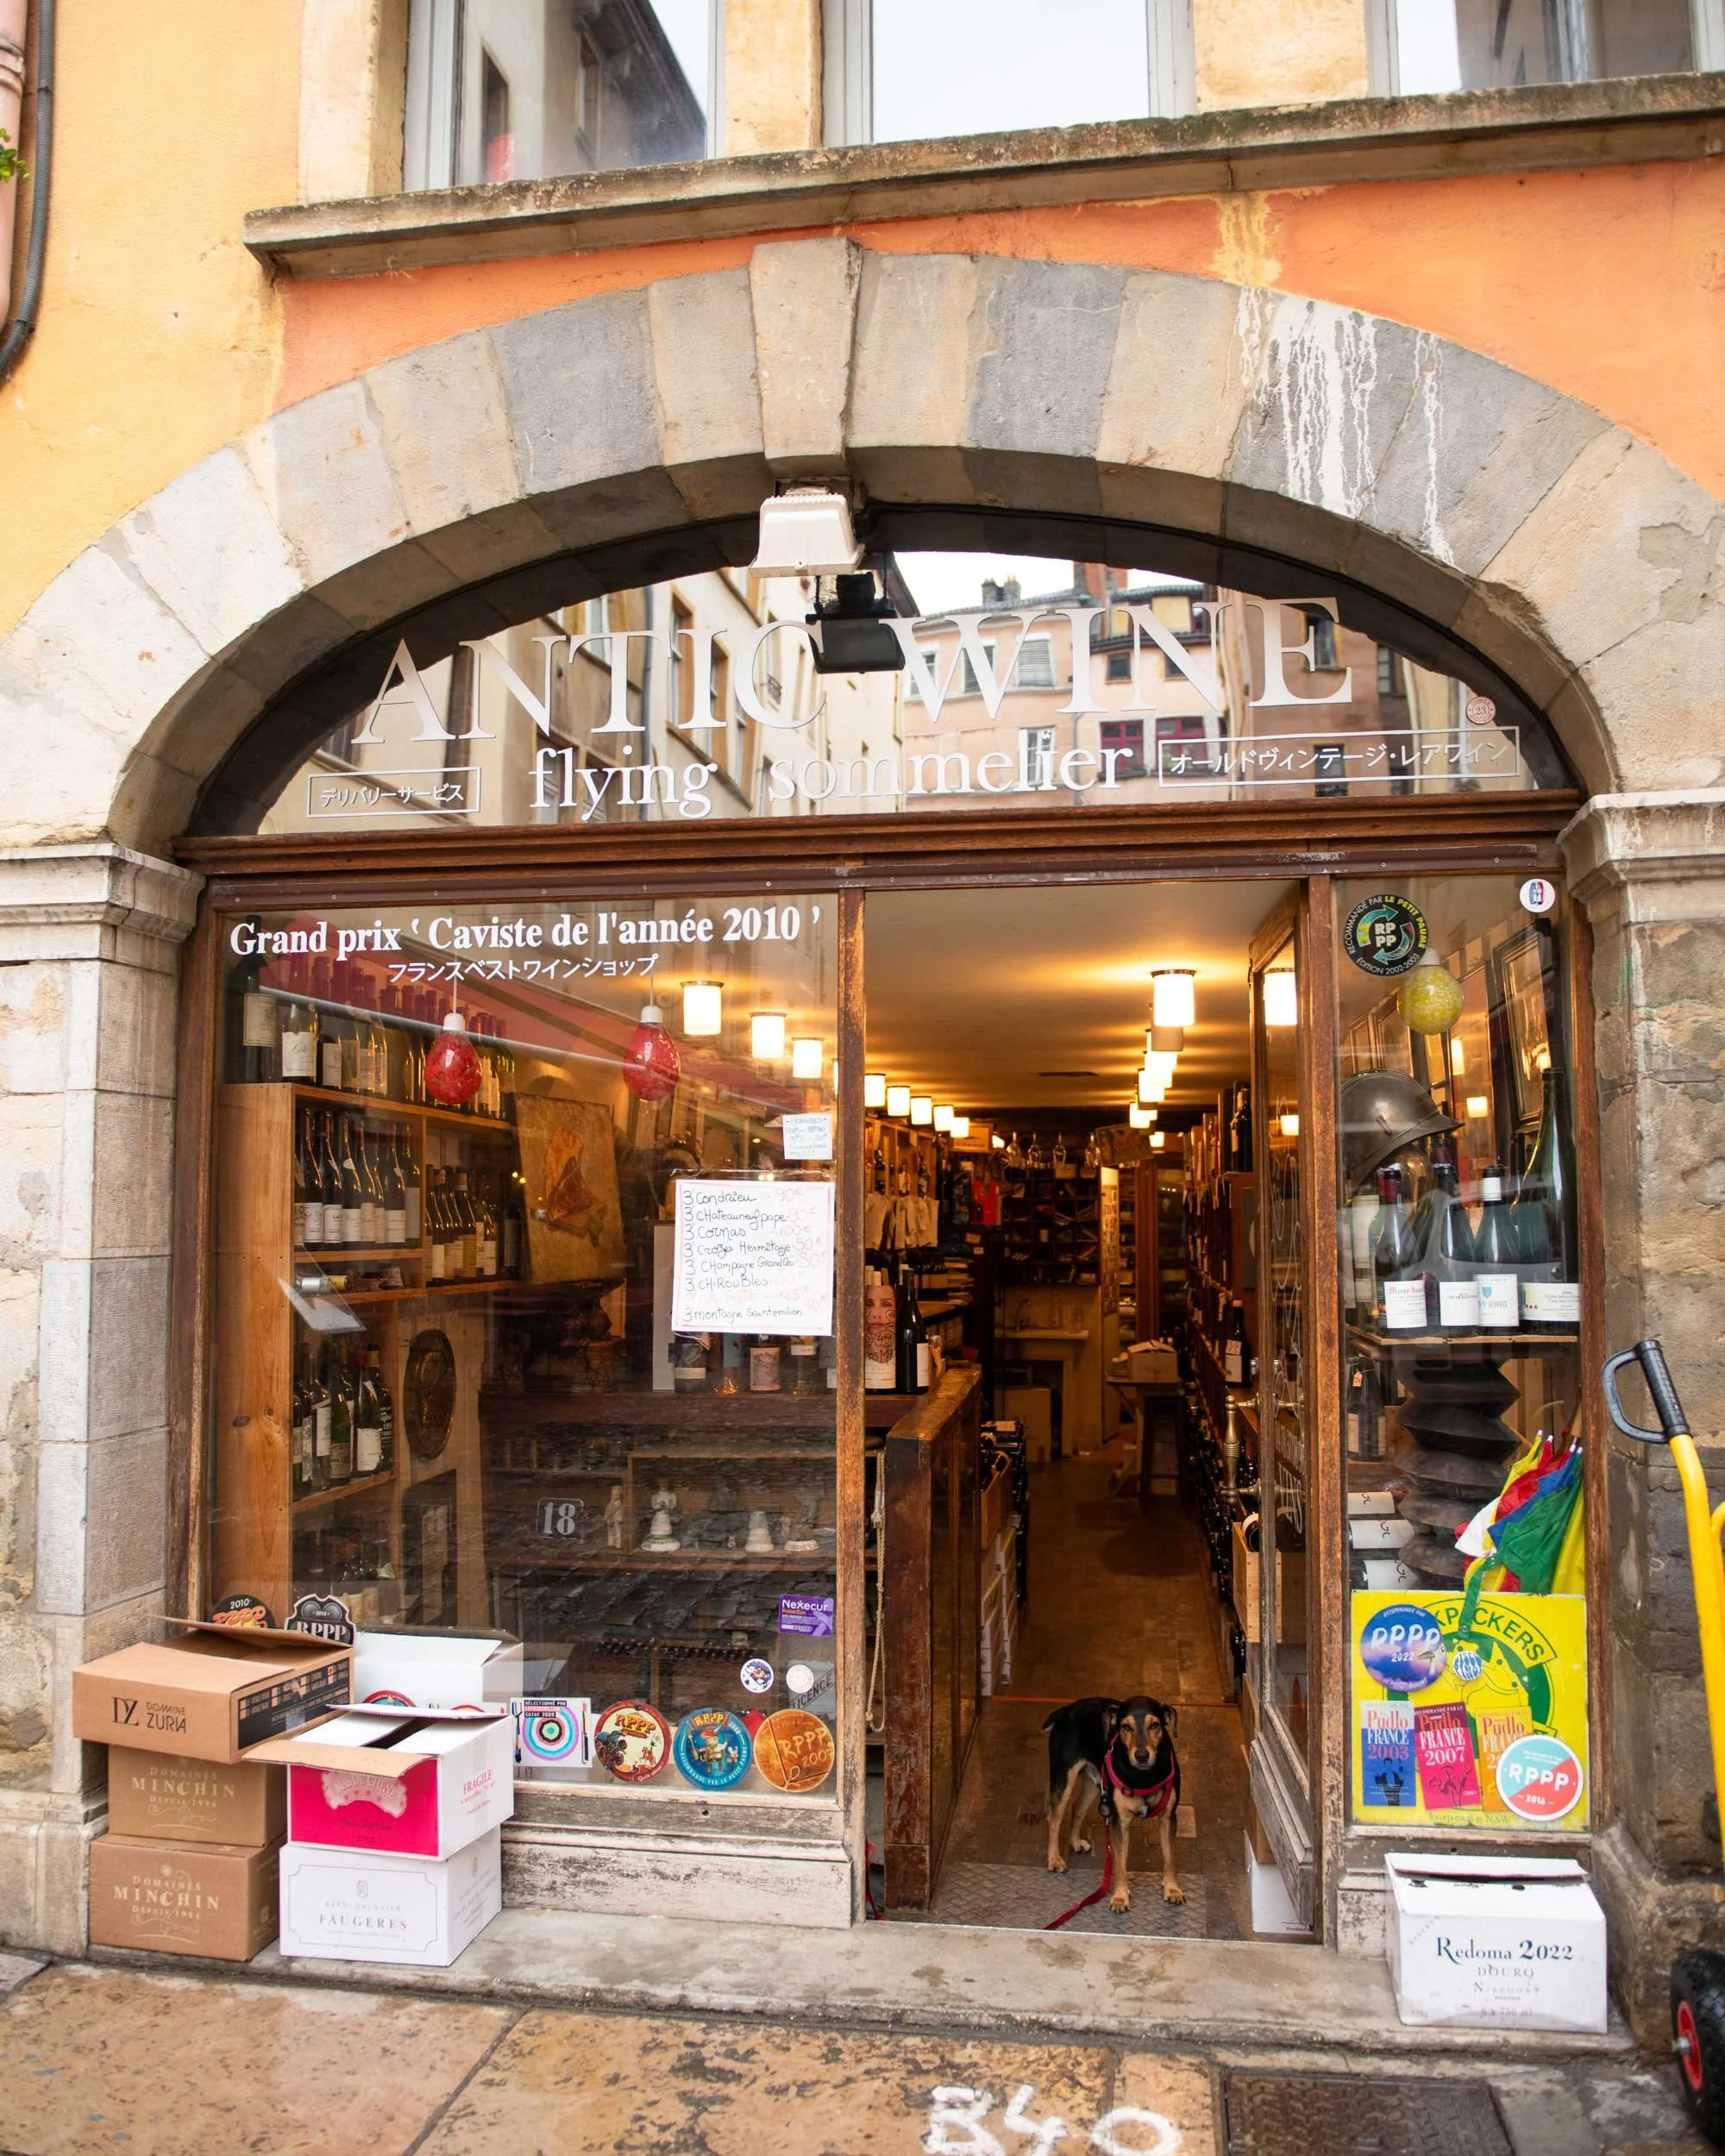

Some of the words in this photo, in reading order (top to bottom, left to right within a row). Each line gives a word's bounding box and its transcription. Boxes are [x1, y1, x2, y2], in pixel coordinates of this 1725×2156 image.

[350, 618, 826, 744] ANTIC
[878, 596, 1352, 723] WINE
[1170, 743, 1508, 774] オールドヴィンテージ・レアワイン
[528, 744, 718, 822] flying
[768, 728, 1133, 803] sommelier
[320, 783, 465, 808] デリバリーサービス
[1368, 896, 1383, 906] PAR
[1397, 898, 1420, 916] PETIT
[229, 920, 333, 956] Grand
[336, 918, 402, 961] prix
[428, 912, 543, 950] Caviste
[551, 912, 589, 947] de
[597, 909, 714, 945] l'année
[723, 906, 800, 943] 2010
[1374, 922, 1396, 935] RP
[1376, 935, 1396, 947] PP
[388, 954, 659, 984] フランスベストワインショップ
[1385, 953, 1420, 975] 2002-2003
[543, 1501, 575, 1535] 18
[229, 1598, 250, 1609] 2010
[781, 1599, 829, 1612] Nexecur
[1434, 1606, 1545, 1662] KPCKERS
[146, 1702, 186, 1716] DOMAINE
[1367, 1710, 1408, 1729] Pudlo
[146, 1713, 186, 1734] ZURIA
[1419, 1712, 1461, 1733] Pudlo
[1483, 1716, 1525, 1736] Pudlo
[1367, 1728, 1409, 1745] FRANCE
[1419, 1727, 1465, 1751] FRANCE
[1367, 1744, 1409, 1760] 2003
[1424, 1746, 1465, 1766] 2007
[131, 1777, 235, 1798] MINCHIN
[463, 1769, 492, 1795] FRAGILE
[1509, 1762, 1570, 1792] RPPP
[1525, 1794, 1546, 1805] 2016
[114, 1886, 219, 1910] MINCHIN
[1436, 1936, 1512, 1965] Redoma
[1519, 1940, 1574, 1960] 2022
